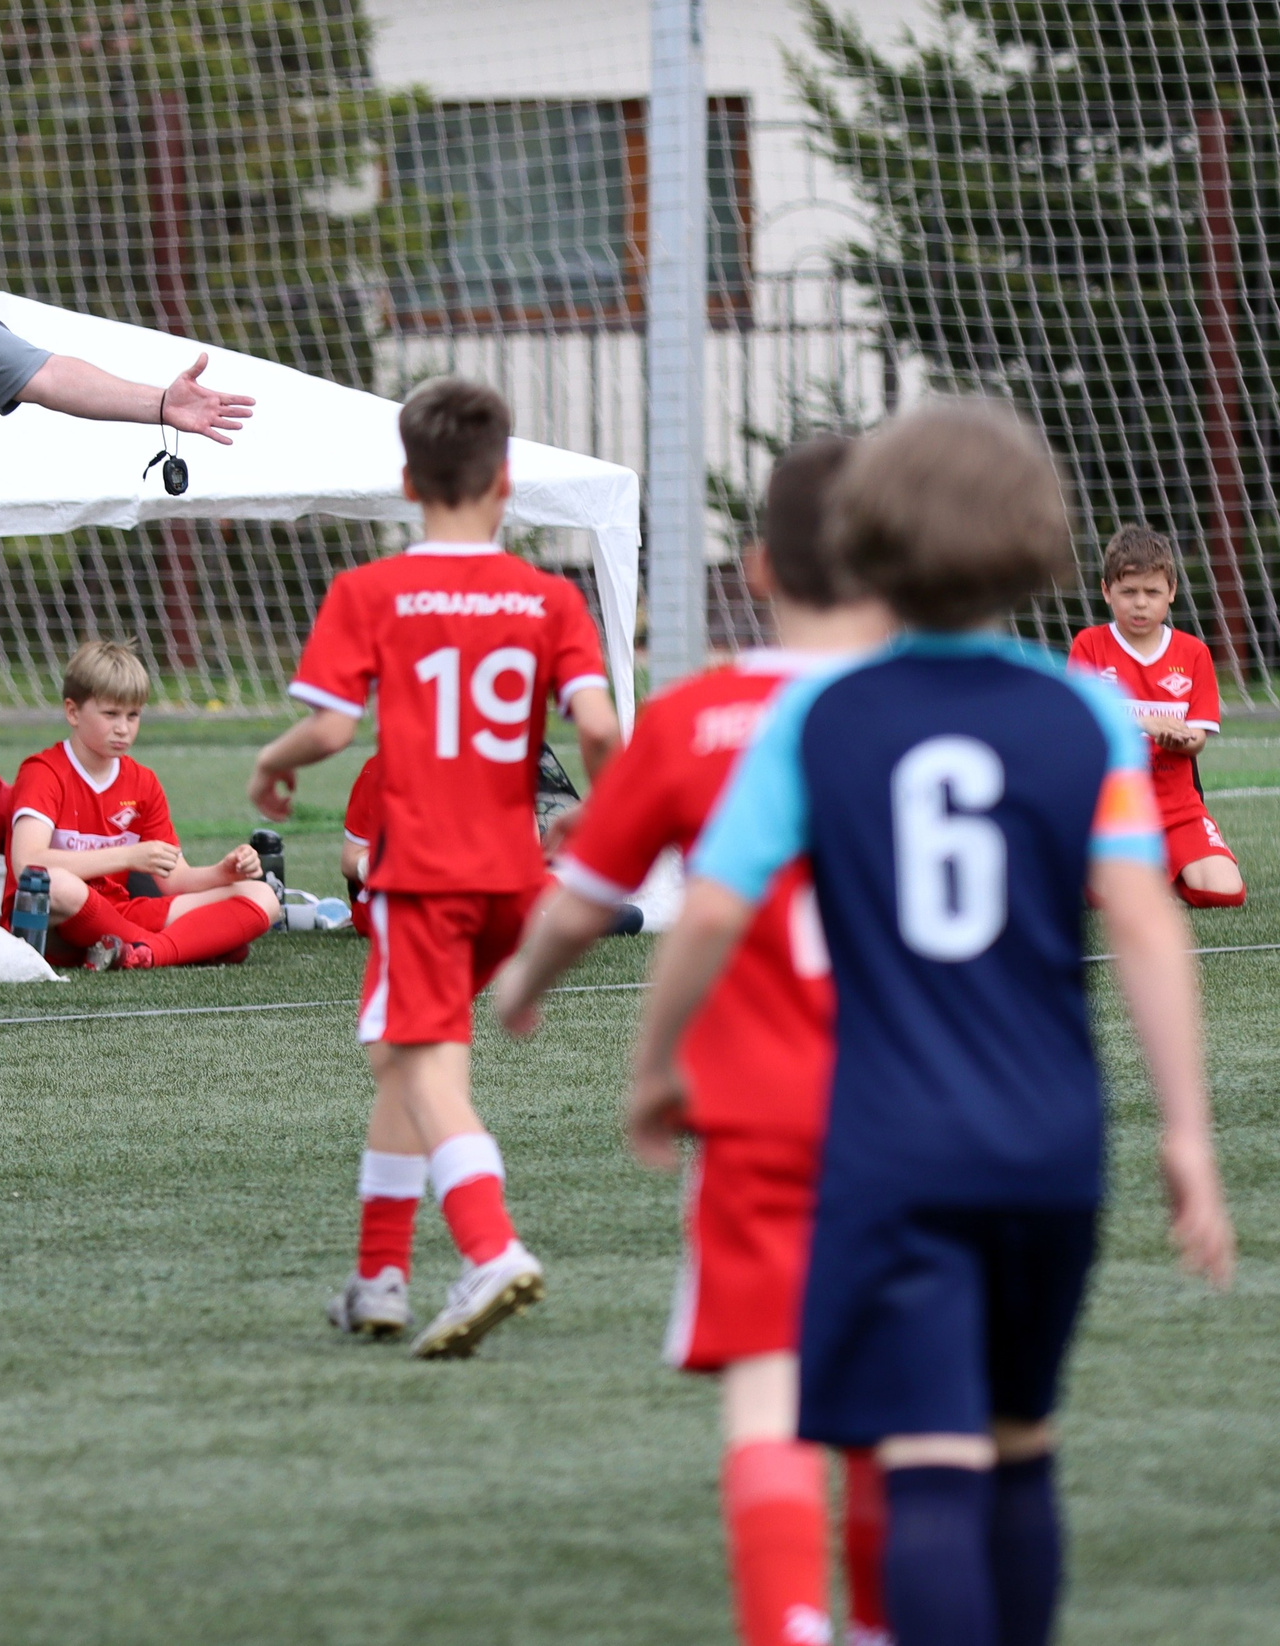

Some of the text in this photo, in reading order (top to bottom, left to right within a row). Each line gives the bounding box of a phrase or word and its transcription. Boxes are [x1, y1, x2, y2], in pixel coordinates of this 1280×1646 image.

[396, 591, 546, 618] КОВАЛЬЧУК
[414, 646, 537, 763] 19
[890, 733, 1008, 964] 6
